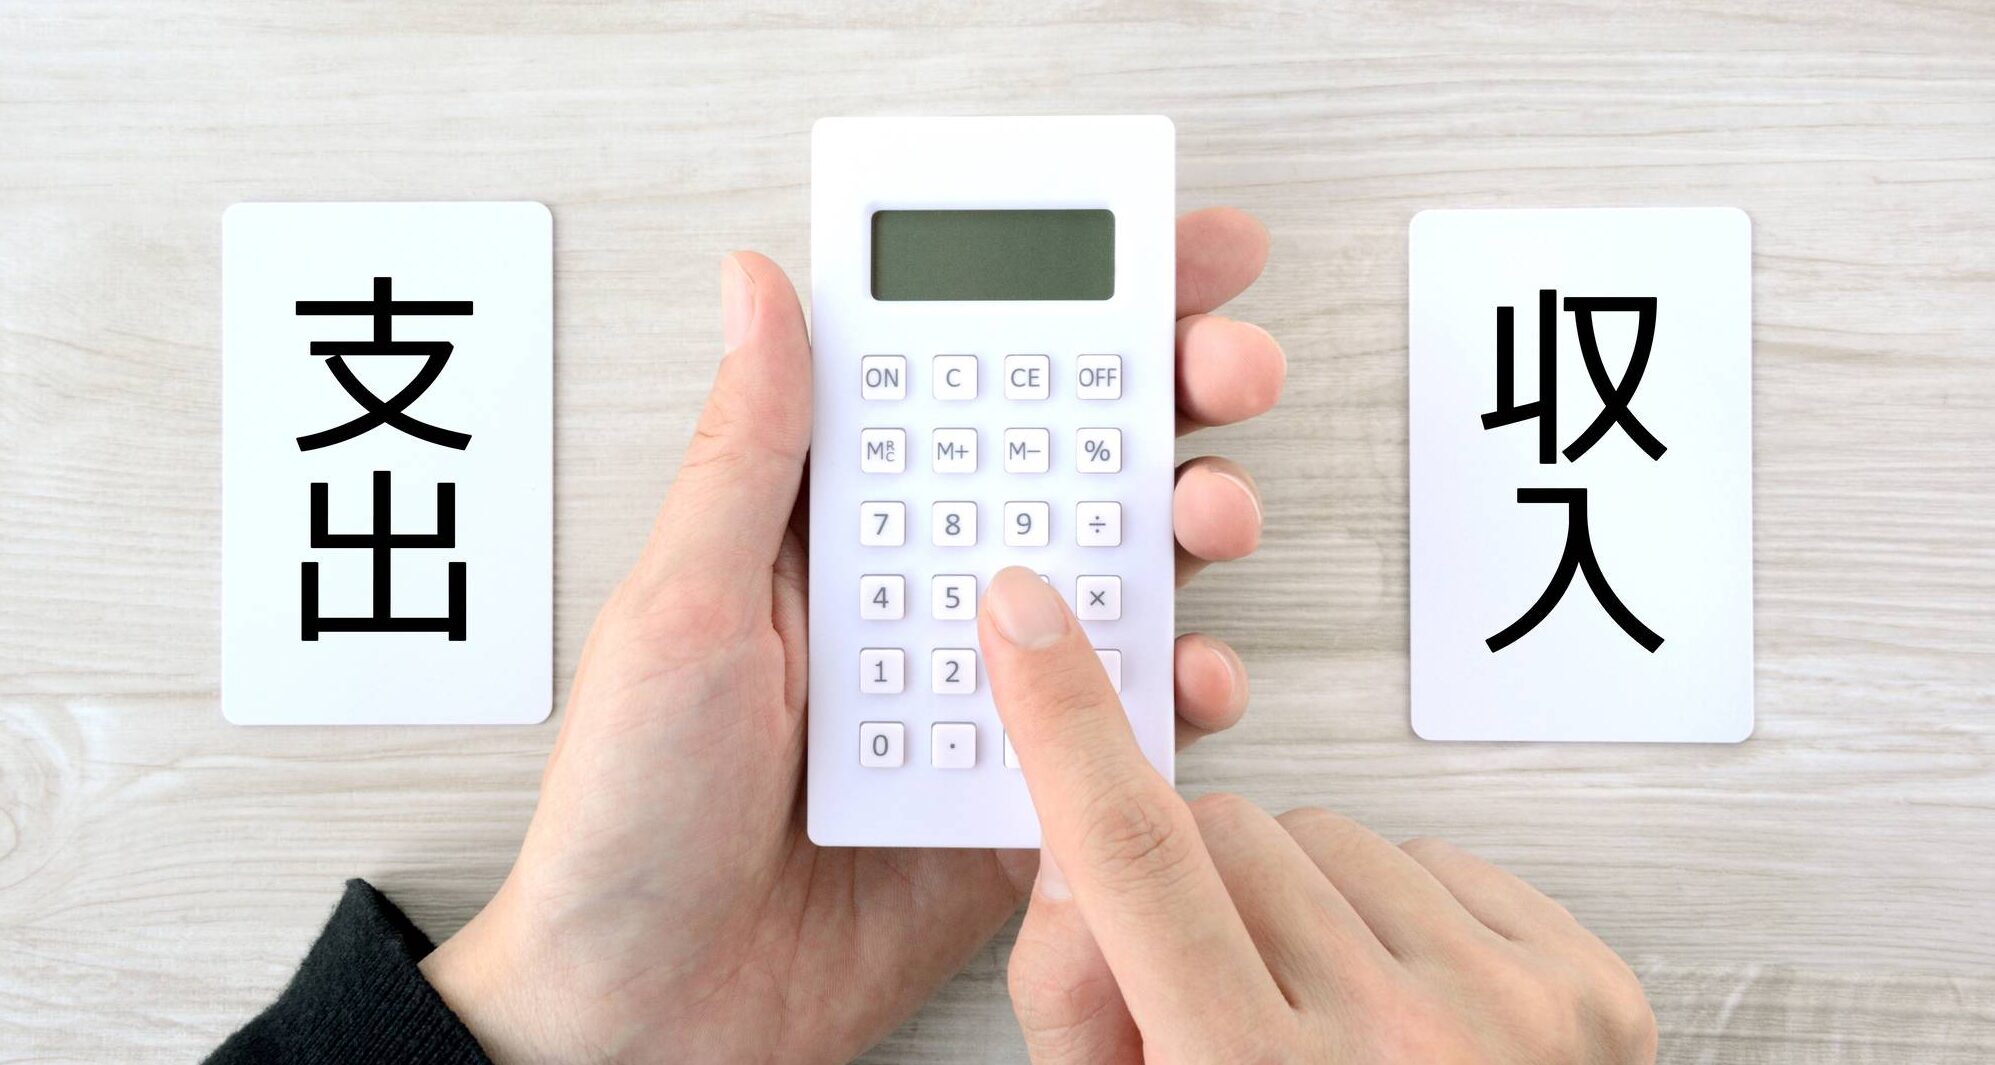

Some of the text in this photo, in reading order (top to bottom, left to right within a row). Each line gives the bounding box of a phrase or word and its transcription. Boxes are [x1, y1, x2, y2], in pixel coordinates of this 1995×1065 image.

[866, 368, 898, 387] ON
[946, 369, 960, 387] C
[1011, 368, 1040, 387] CE
[1079, 368, 1116, 387] OFF
[296, 277, 473, 641] 支出
[938, 442, 968, 460] M+
[1085, 440, 1110, 461] %
[1481, 290, 1667, 653] 収入
[874, 514, 888, 535] 7
[945, 514, 960, 535] 8
[1017, 513, 1031, 535] 9
[873, 587, 889, 608] 4
[946, 587, 960, 608] 5
[874, 660, 887, 682] 1
[945, 661, 960, 682] 2
[873, 734, 889, 757] 0
